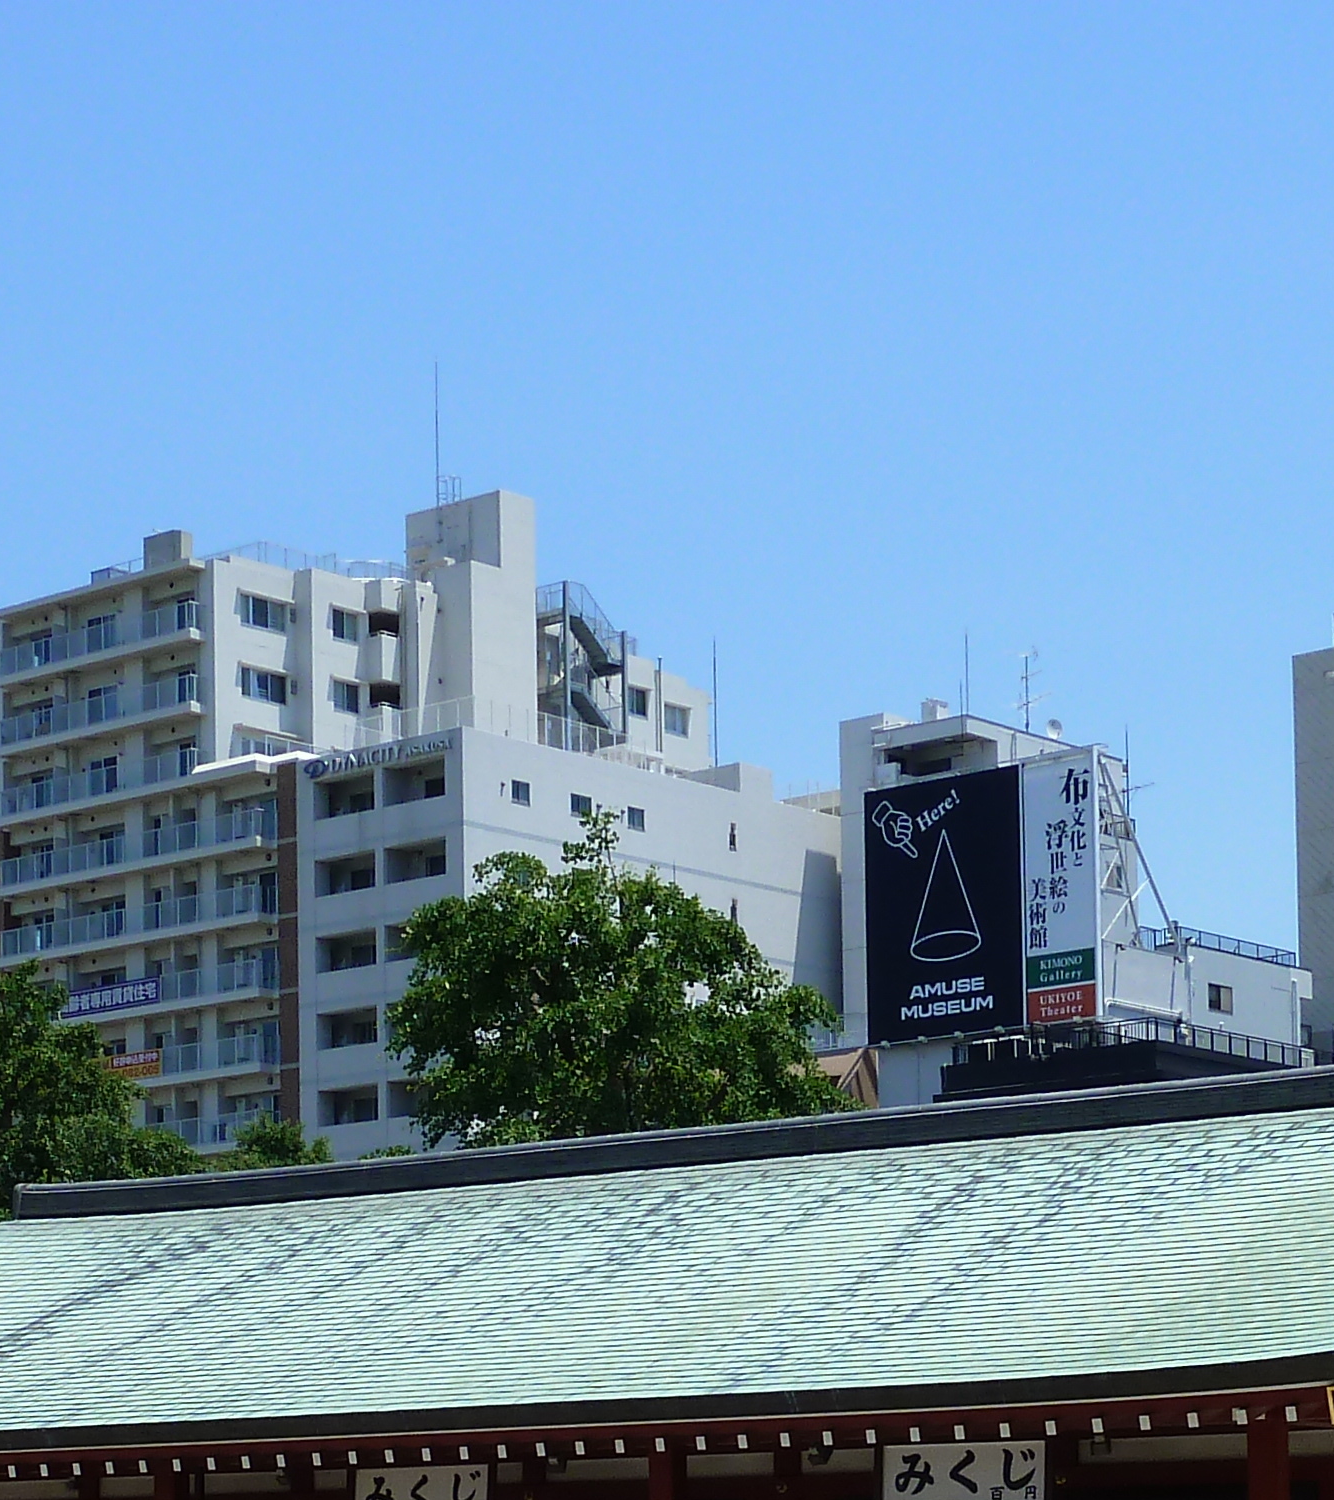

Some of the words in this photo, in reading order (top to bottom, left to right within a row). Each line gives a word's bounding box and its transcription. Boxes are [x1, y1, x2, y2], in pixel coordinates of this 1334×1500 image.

[916, 788, 961, 833] Here!
[1045, 819, 1068, 914] 浮世絵の
[1028, 878, 1048, 950] 美術館
[1039, 954, 1083, 970] KIMONO
[909, 976, 985, 1000] AMUSE
[1039, 968, 1083, 983] Gallery
[901, 995, 994, 1021] MUSEUM
[1039, 990, 1083, 1005] UKIYOE
[1039, 1003, 1083, 1017] Theater
[894, 1448, 1037, 1495] みくじ
